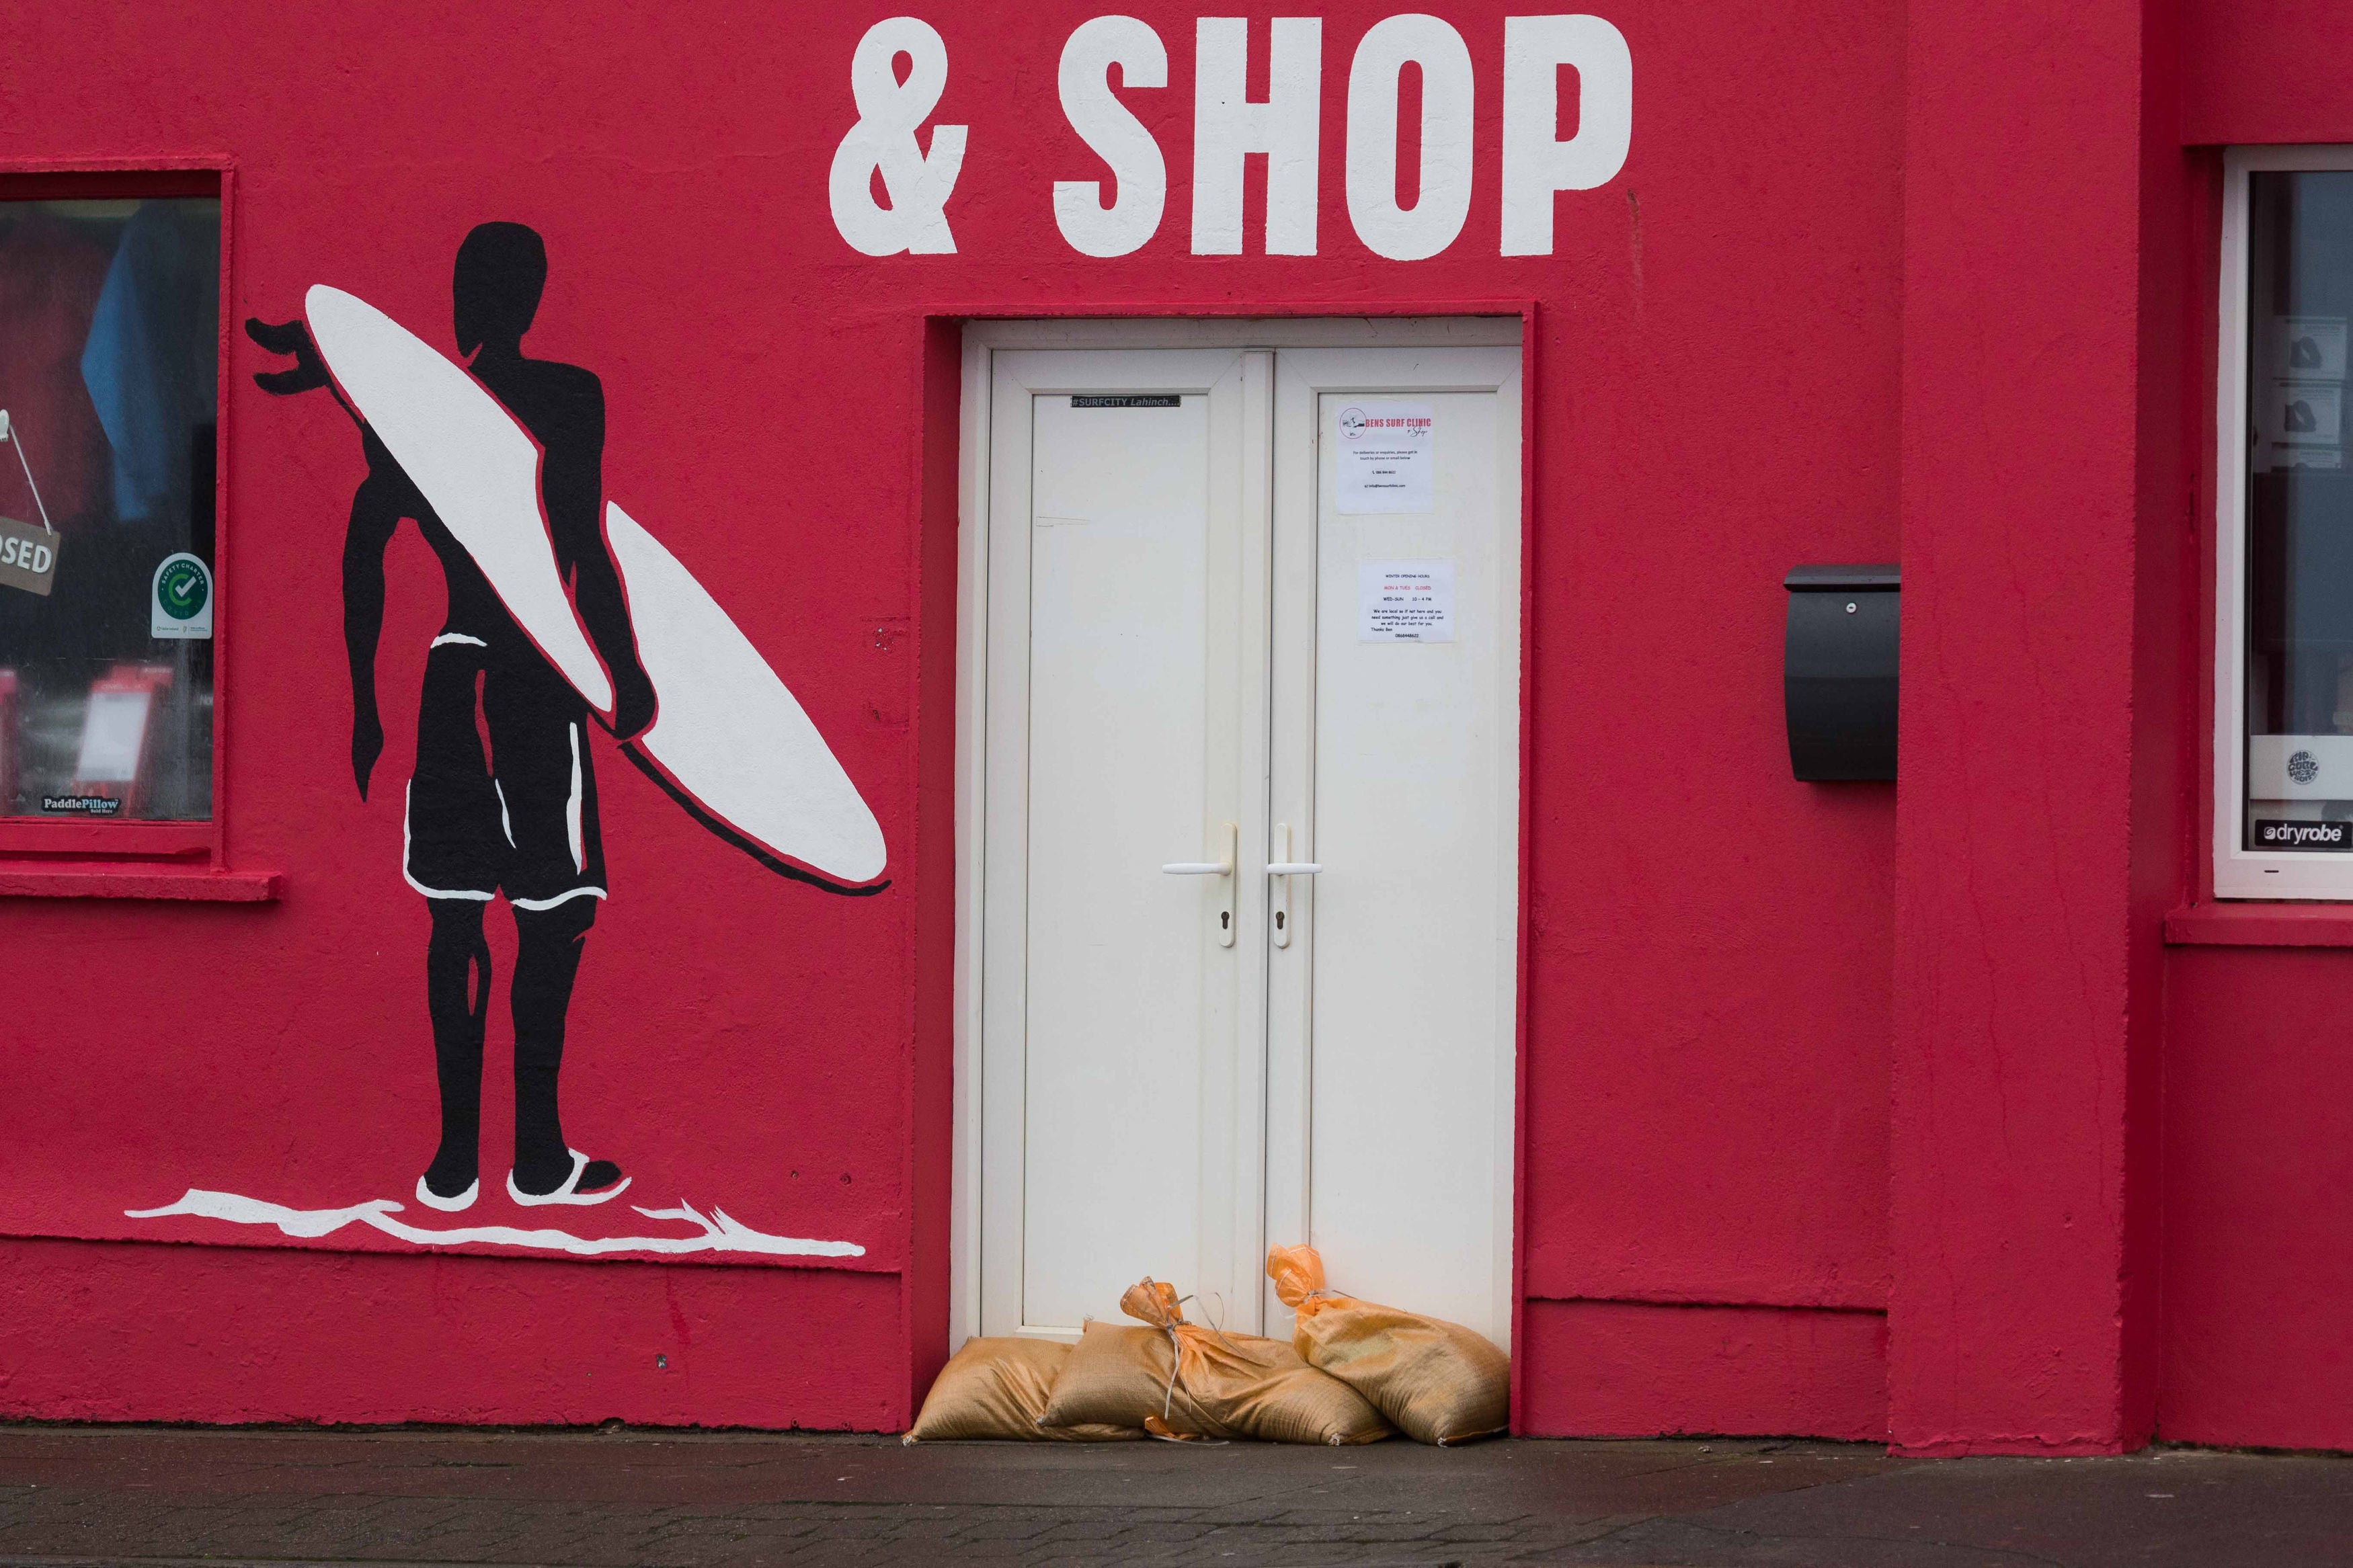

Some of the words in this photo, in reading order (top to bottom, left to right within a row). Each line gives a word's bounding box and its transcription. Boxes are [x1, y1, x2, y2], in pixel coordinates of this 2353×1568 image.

[829, 15, 968, 257] &
[1053, 13, 1633, 261] SHOP
[1072, 398, 1127, 407] #SURFCITY
[1365, 419, 1384, 427] BENS
[1386, 419, 1405, 427] SURF
[1406, 418, 1431, 427] CLINIC
[161, 563, 180, 584] SAFETY
[182, 563, 204, 585] CHARTER
[2288, 761, 2318, 771] CURL
[44, 798, 118, 809] PaddlePillow
[2276, 823, 2342, 845] dryrobe
